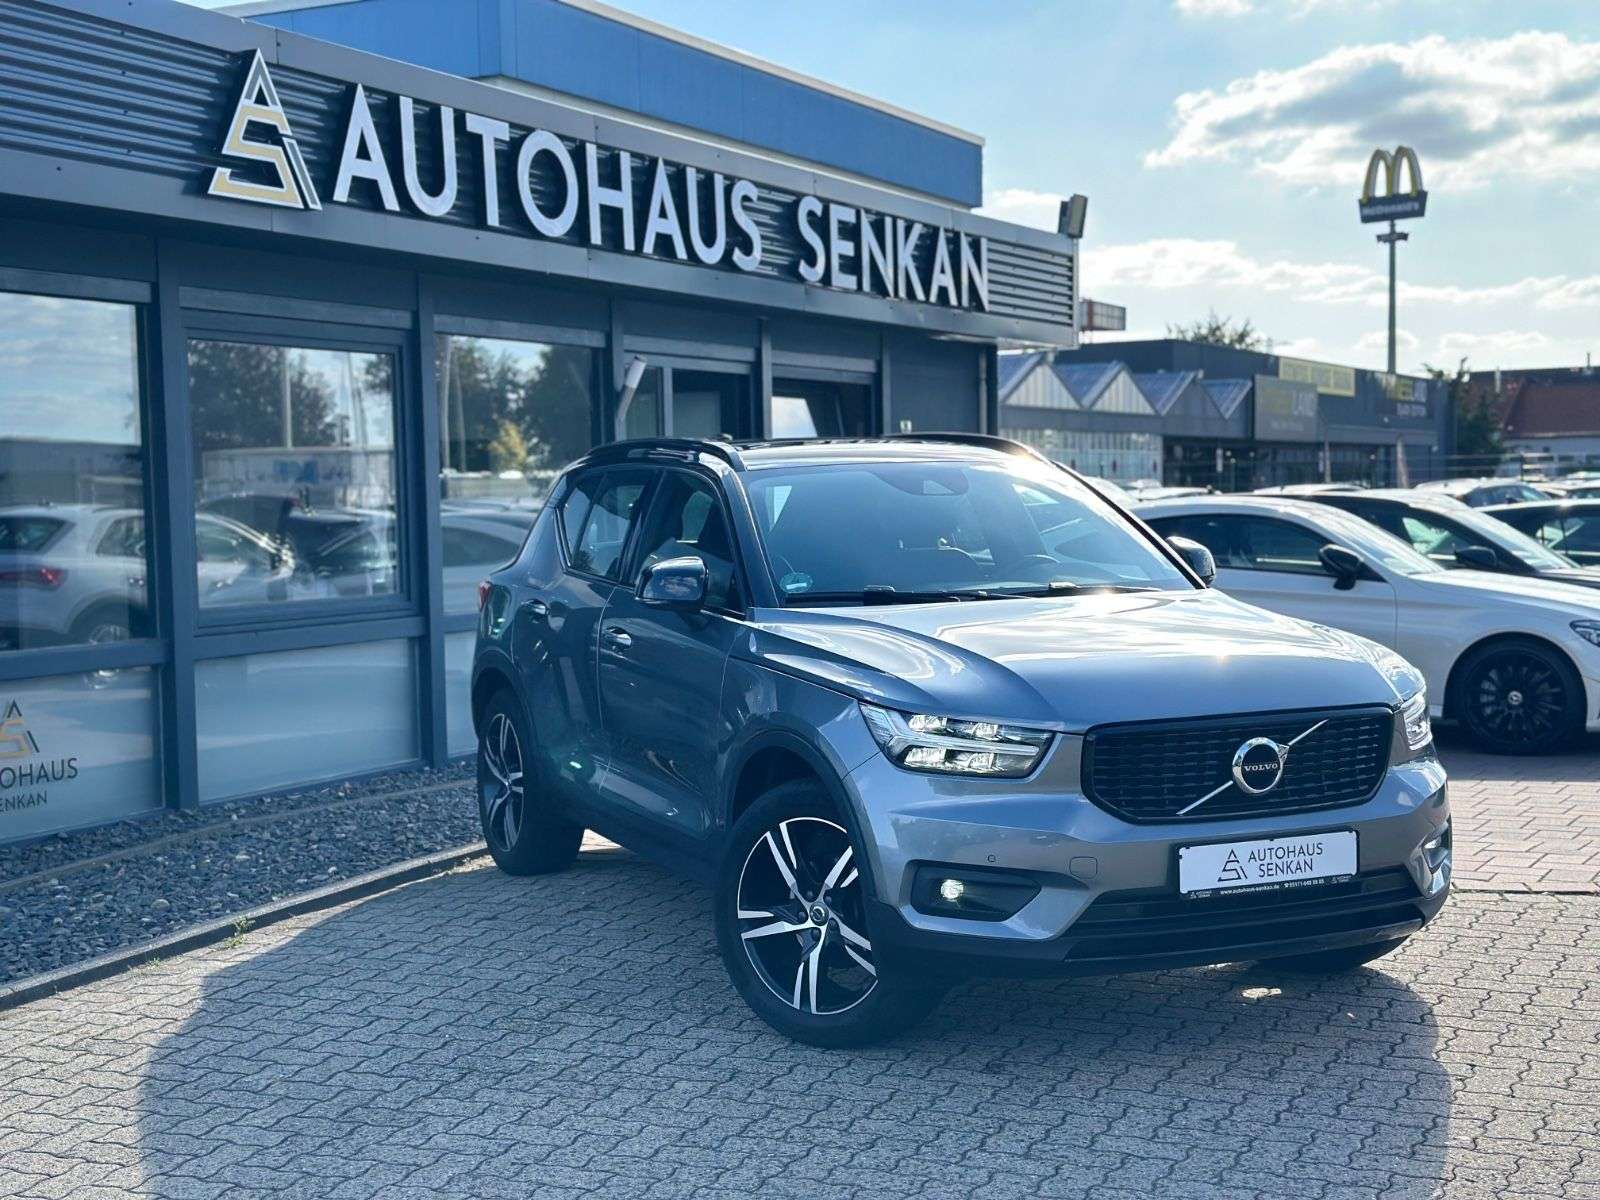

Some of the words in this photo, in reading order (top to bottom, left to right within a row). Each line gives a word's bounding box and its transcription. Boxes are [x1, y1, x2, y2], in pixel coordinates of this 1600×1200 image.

[333, 83, 762, 271] AUTOHAUS
[798, 195, 989, 312] SENKAN
[1244, 763, 1278, 772] VOLVO
[1248, 842, 1323, 863] AUTOHAUS
[1258, 858, 1313, 878] SENKAN
